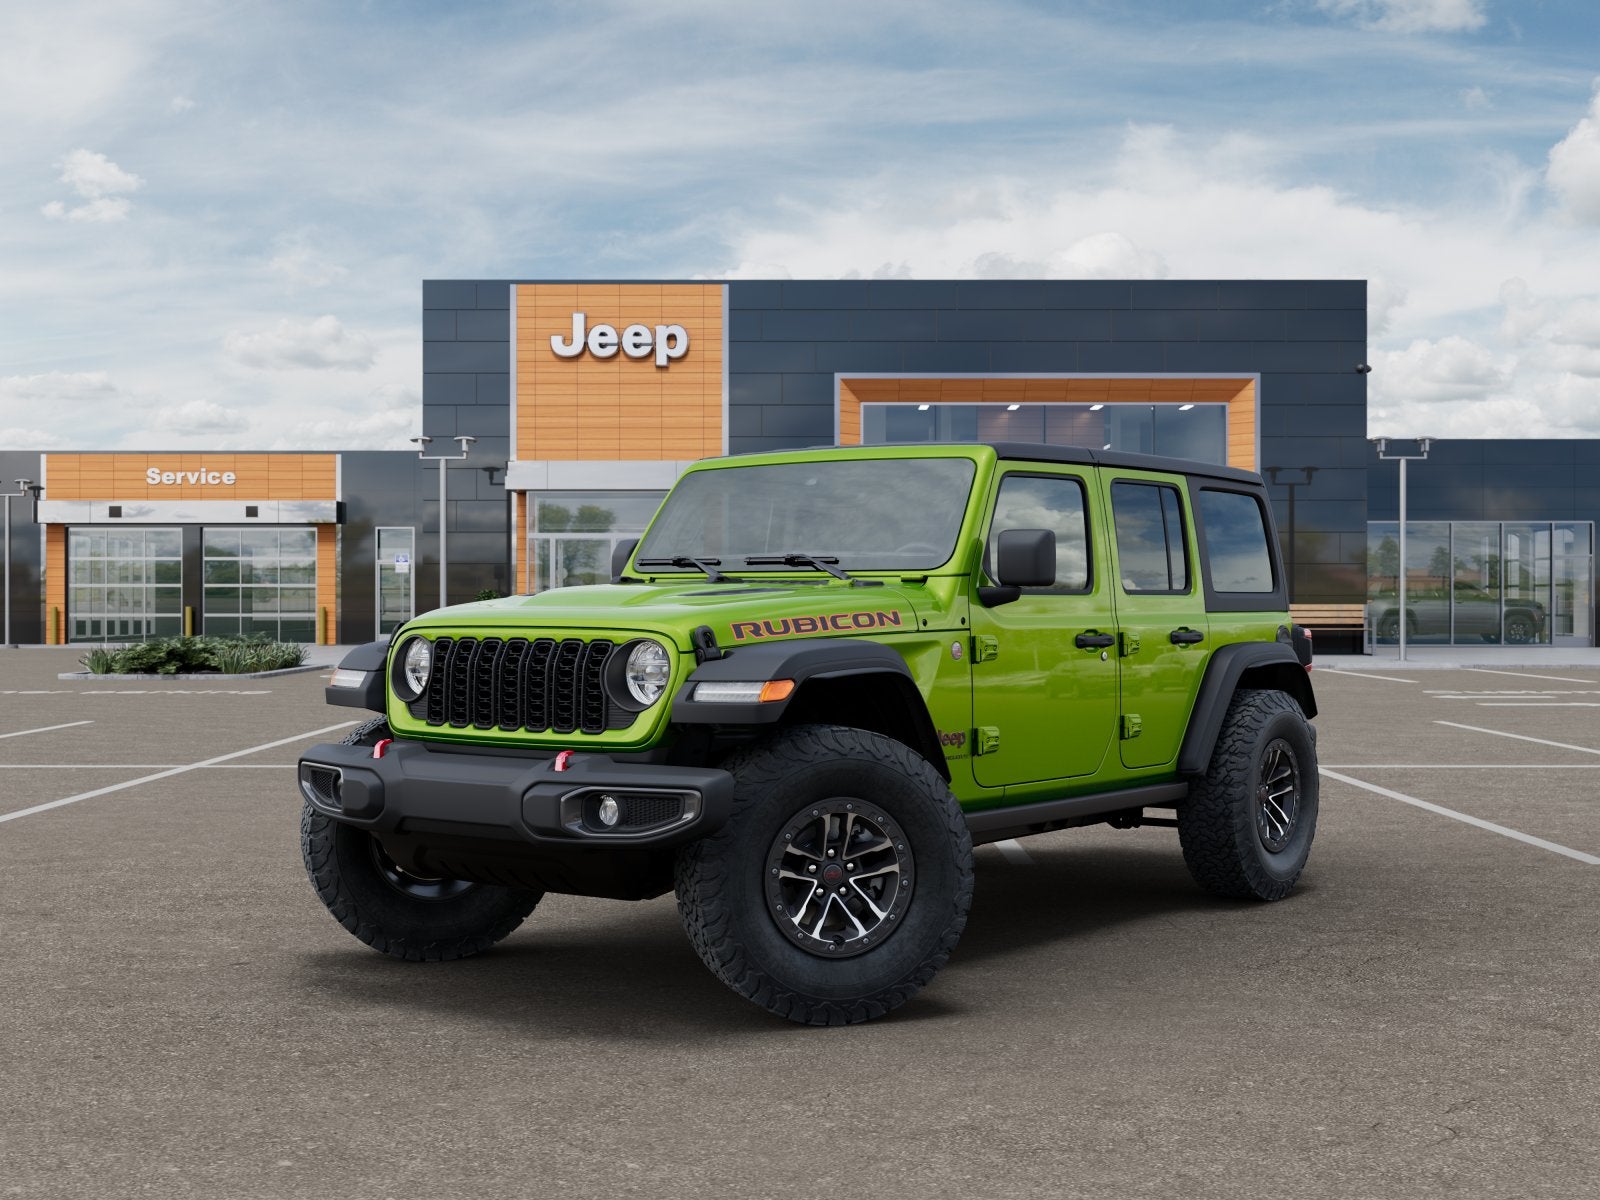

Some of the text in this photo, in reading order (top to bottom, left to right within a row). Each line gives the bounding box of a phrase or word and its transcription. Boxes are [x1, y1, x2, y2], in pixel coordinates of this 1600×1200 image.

[550, 312, 690, 368] Jeep
[146, 468, 236, 485] Service
[731, 610, 901, 640] RUBICON
